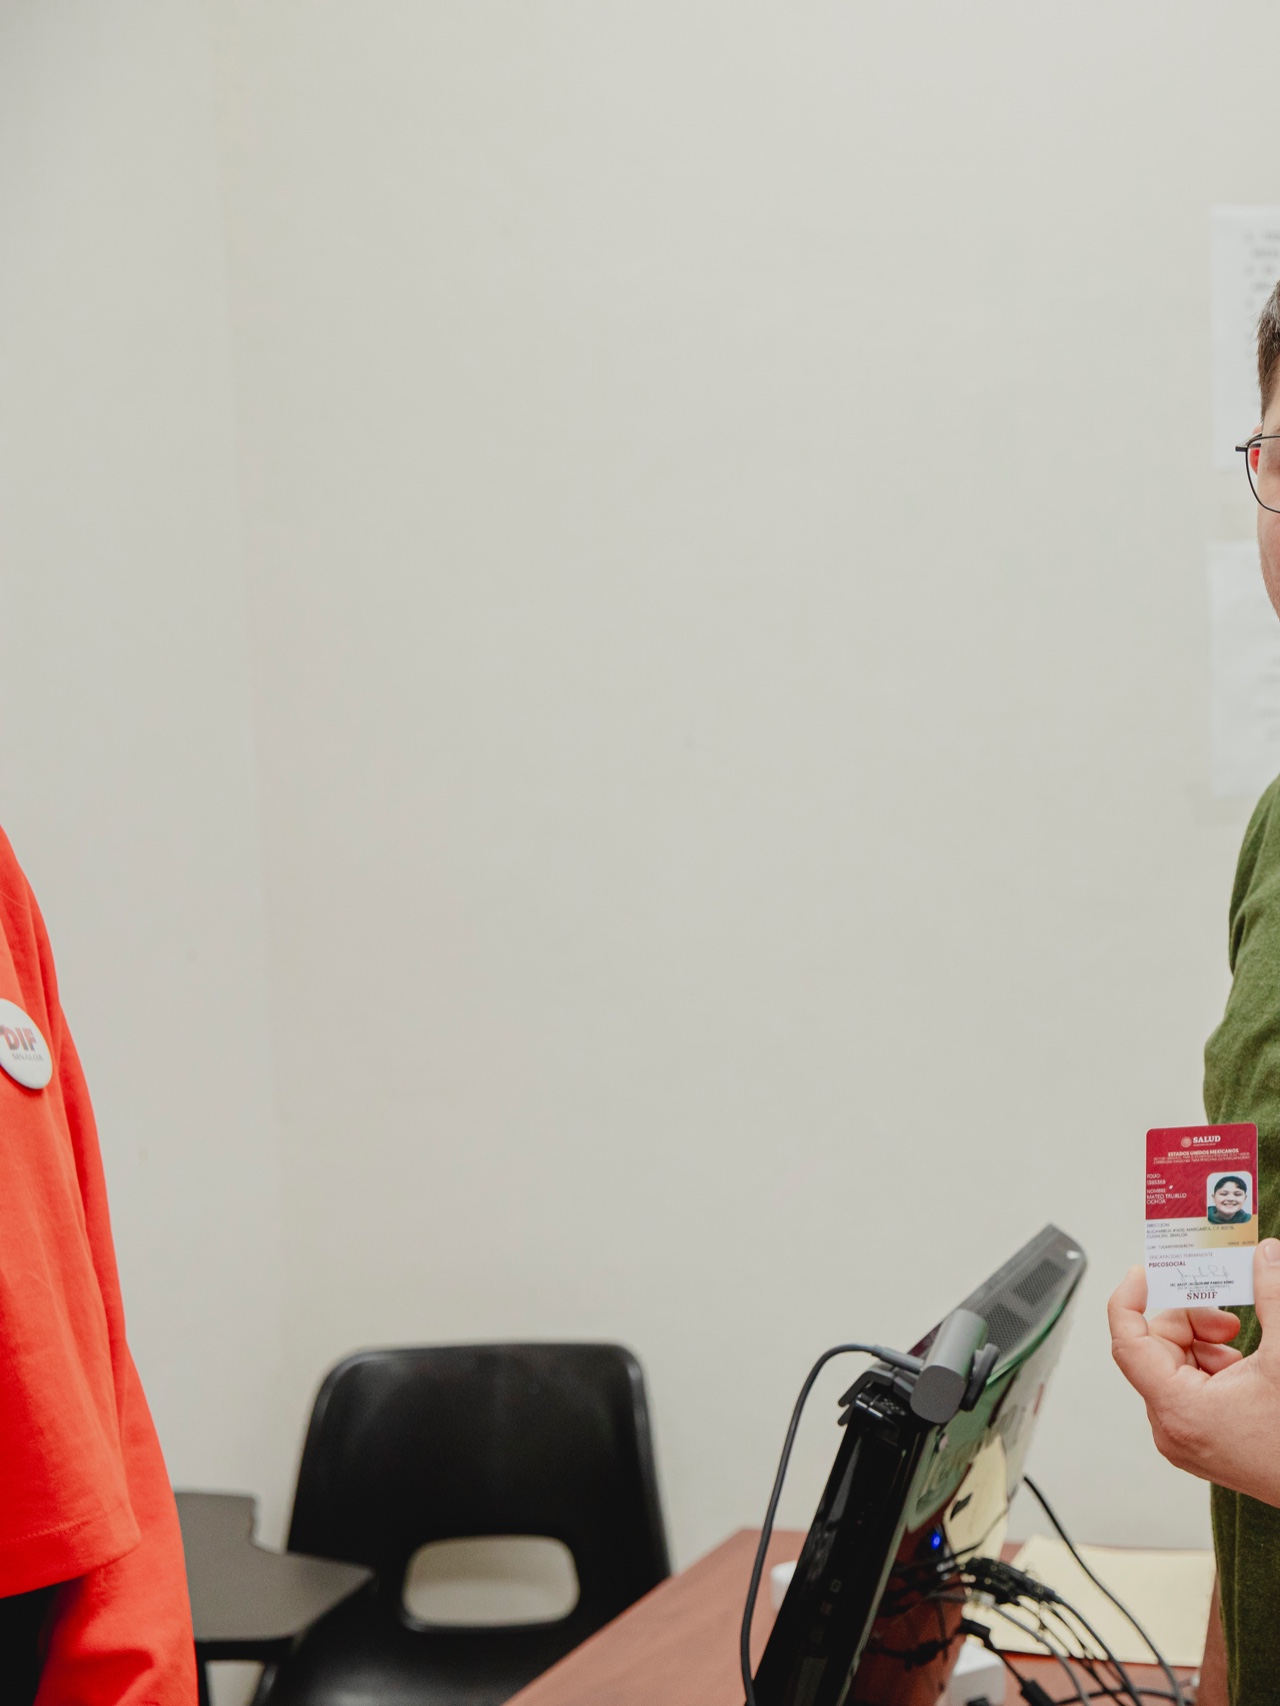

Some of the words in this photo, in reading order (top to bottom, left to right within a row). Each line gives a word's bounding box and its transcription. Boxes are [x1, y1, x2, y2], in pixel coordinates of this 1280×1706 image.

[4, 1027, 37, 1052] DIF
[1193, 1135, 1221, 1143] SALUD
[1186, 1291, 1218, 1300] SNDIF
